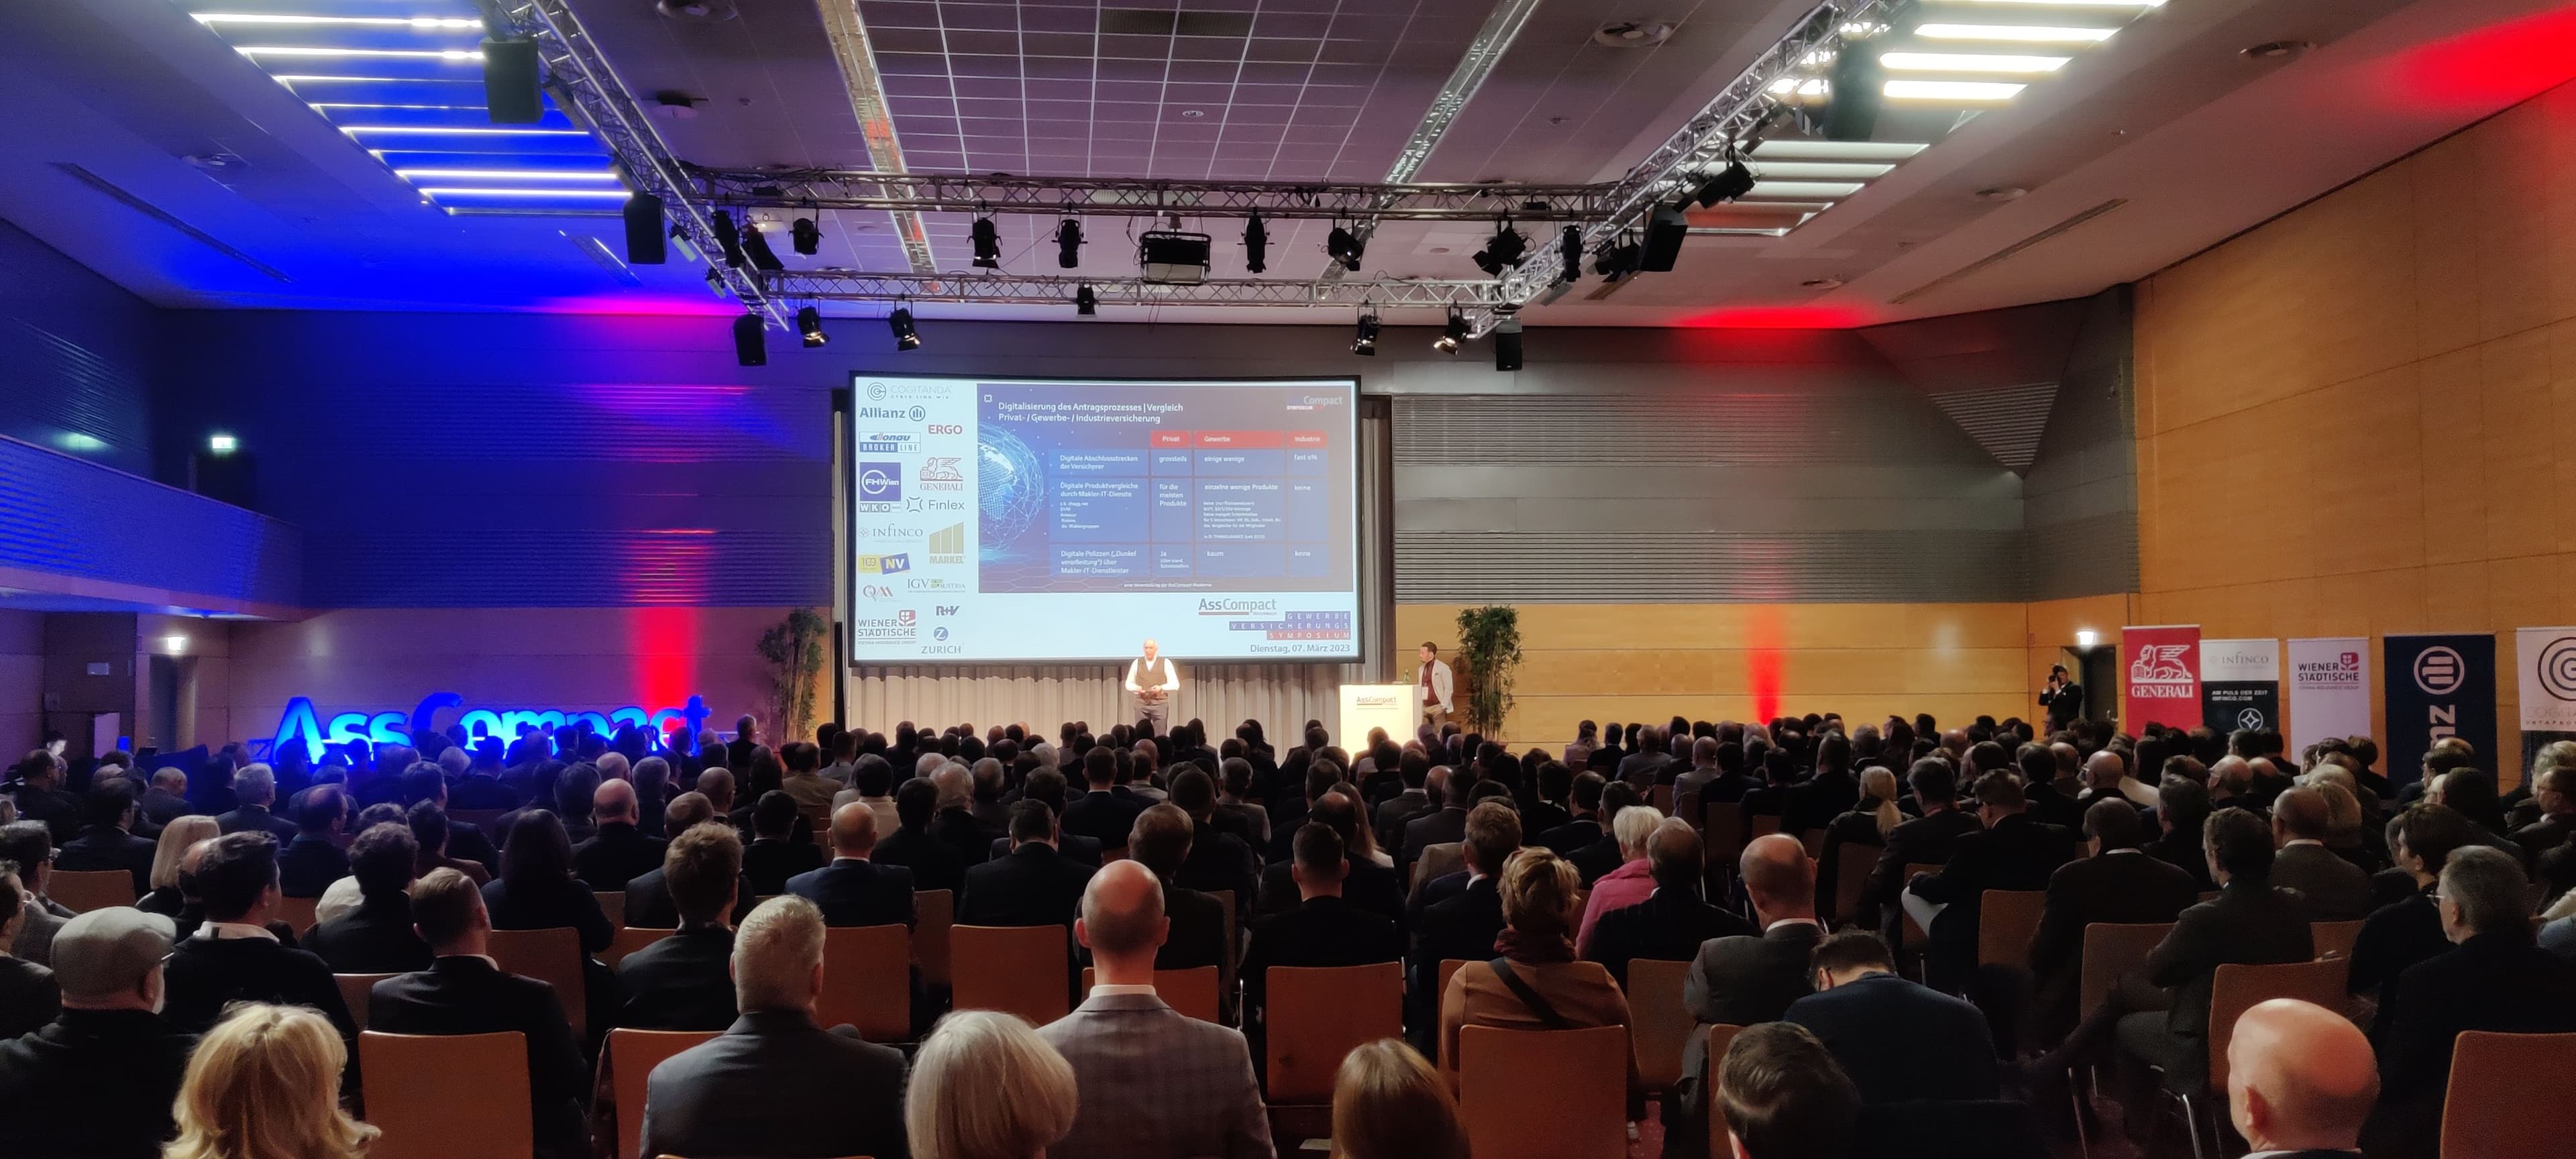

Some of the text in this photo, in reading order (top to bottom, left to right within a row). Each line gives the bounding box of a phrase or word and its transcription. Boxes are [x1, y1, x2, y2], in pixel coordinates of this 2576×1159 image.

[890, 385, 951, 394] COGITANDA
[998, 402, 1056, 412] Digitalisierung
[1058, 402, 1071, 411] des
[1073, 403, 1142, 413] Antragsprozesses
[1148, 404, 1183, 413] Vergleich
[859, 407, 906, 419] Allianz
[1031, 415, 1070, 423] Gewerbe-
[1076, 415, 1161, 424] Industrieversicherung
[928, 425, 963, 435] ERGO
[869, 433, 911, 441] donau
[863, 443, 895, 451] BROKER
[1060, 455, 1083, 463] Digitale
[920, 483, 963, 491] GENERALI
[1060, 482, 1138, 491] Digitale Produktvergleiche
[860, 503, 890, 512] WKO
[928, 500, 965, 510] Finlex
[885, 559, 905, 569] NV
[929, 555, 964, 564] MARKEL
[908, 579, 930, 589] IGV
[1198, 598, 1277, 613] AssCompact
[936, 606, 960, 616] R+V
[858, 619, 897, 627] WIENER
[858, 628, 916, 637] STÄDTISCHE
[921, 646, 961, 654] ZURICH
[1250, 644, 1290, 653] Dienstag,
[1307, 644, 1328, 652] März
[2298, 662, 2339, 671] WIENER
[2298, 672, 2359, 681] STÄDTISCHE
[2131, 685, 2193, 698] GENERALI
